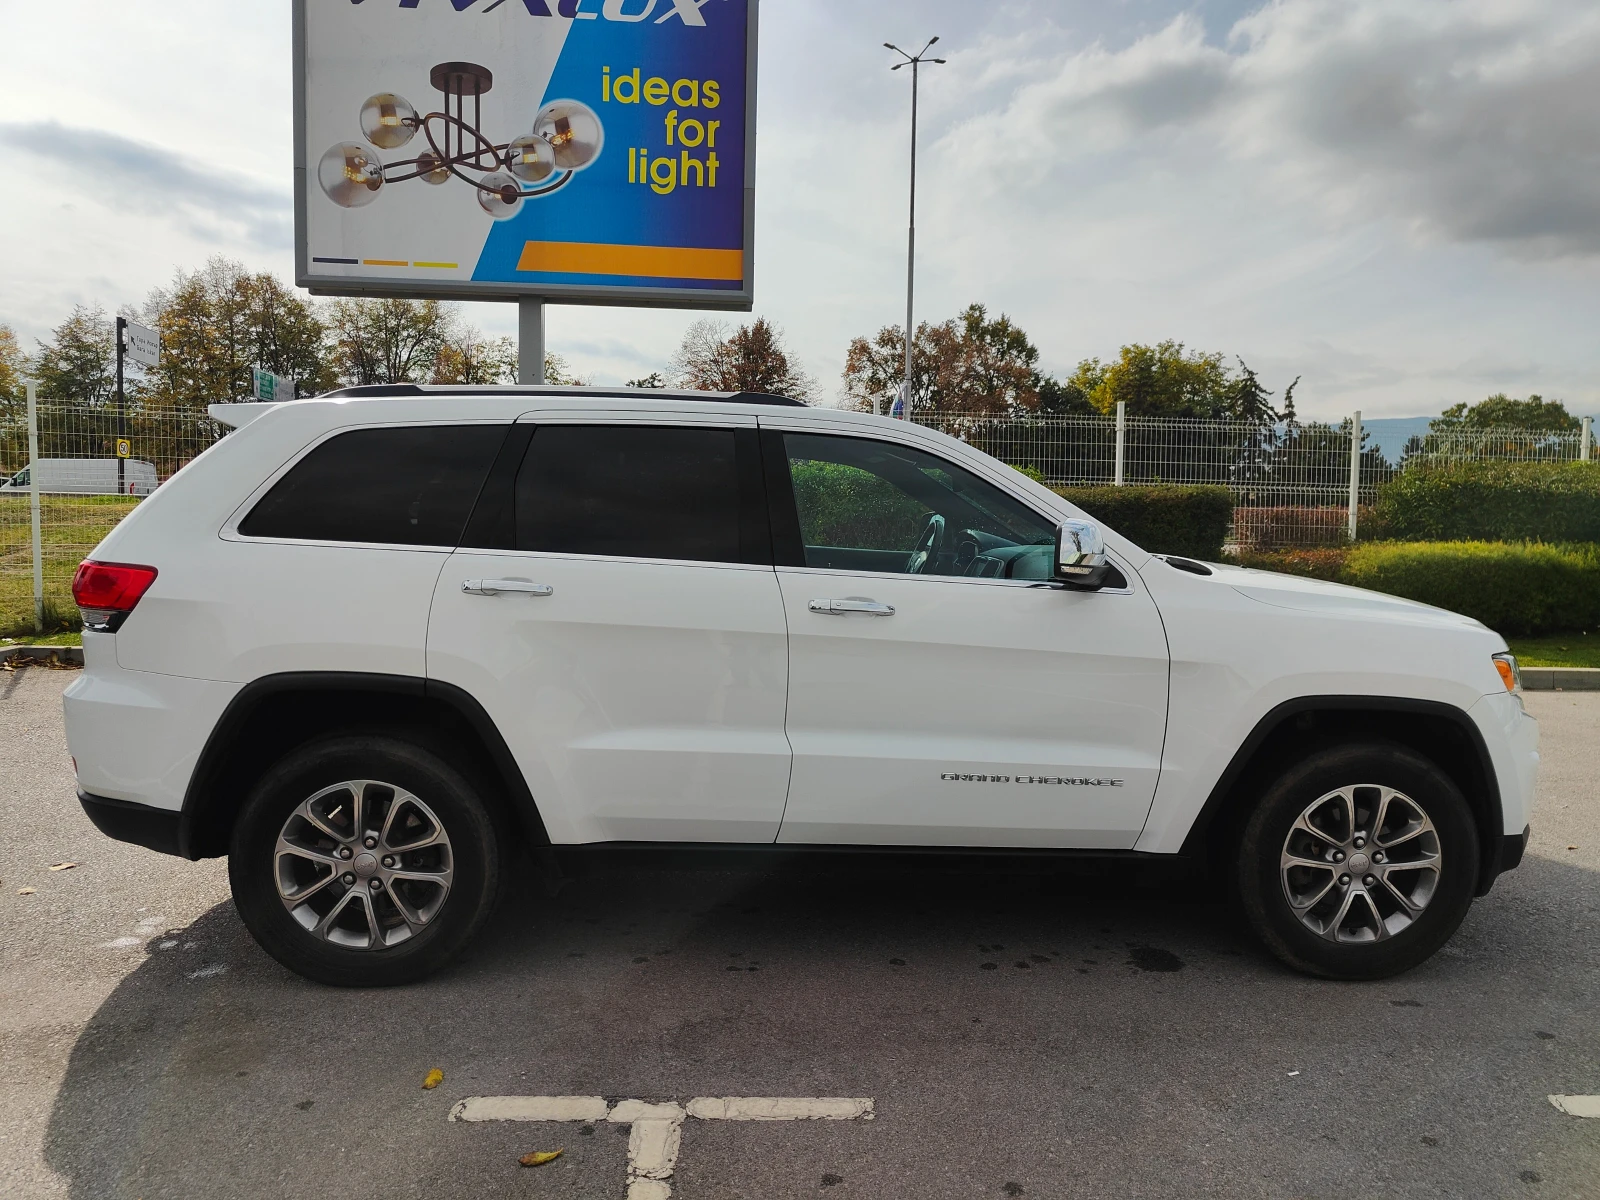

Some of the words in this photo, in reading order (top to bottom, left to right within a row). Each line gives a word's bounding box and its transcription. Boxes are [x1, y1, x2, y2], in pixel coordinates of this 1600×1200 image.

[602, 66, 720, 108] ideas
[664, 109, 720, 148] for
[628, 147, 720, 195] light
[940, 771, 1010, 784] GRAND
[1015, 775, 1125, 787] CHEROKEE
